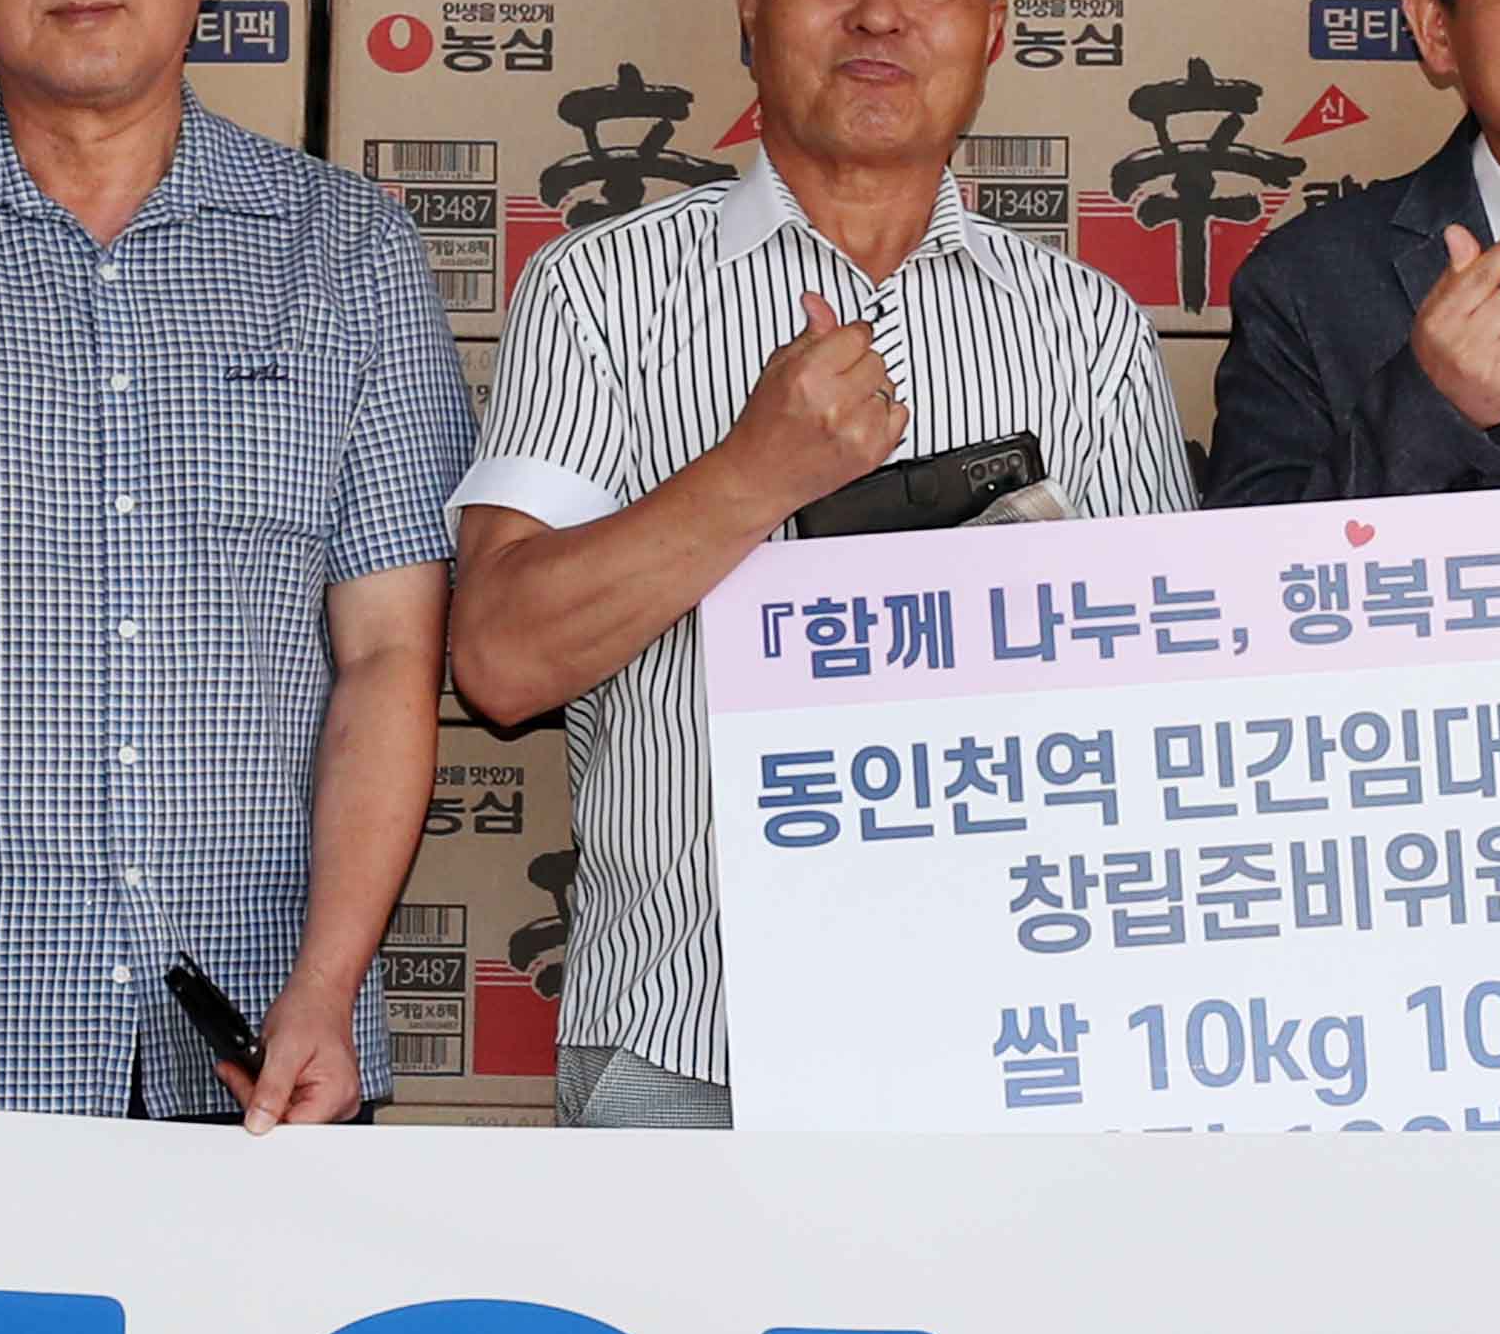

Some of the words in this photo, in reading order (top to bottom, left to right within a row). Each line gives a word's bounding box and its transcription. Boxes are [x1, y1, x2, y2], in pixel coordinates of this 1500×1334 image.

[197, 9, 276, 55] 티팩
[442, 1, 496, 22] 인생을
[498, 2, 555, 24] 맛있게
[1323, 7, 1410, 53] 멀티
[440, 26, 554, 73] 농심
[1012, 21, 1124, 69] 농심
[1319, 97, 1346, 124] 신
[409, 194, 493, 224] 가3487
[981, 188, 1065, 218] 가3487
[759, 591, 956, 680] 『함께
[986, 569, 1251, 661] 나누는,
[433, 764, 466, 786] 생을
[468, 764, 525, 786] 맛있게
[755, 724, 1119, 849] 동인천역
[992, 1001, 1090, 1109] 쌀
[1127, 996, 1369, 1107] 10kg
